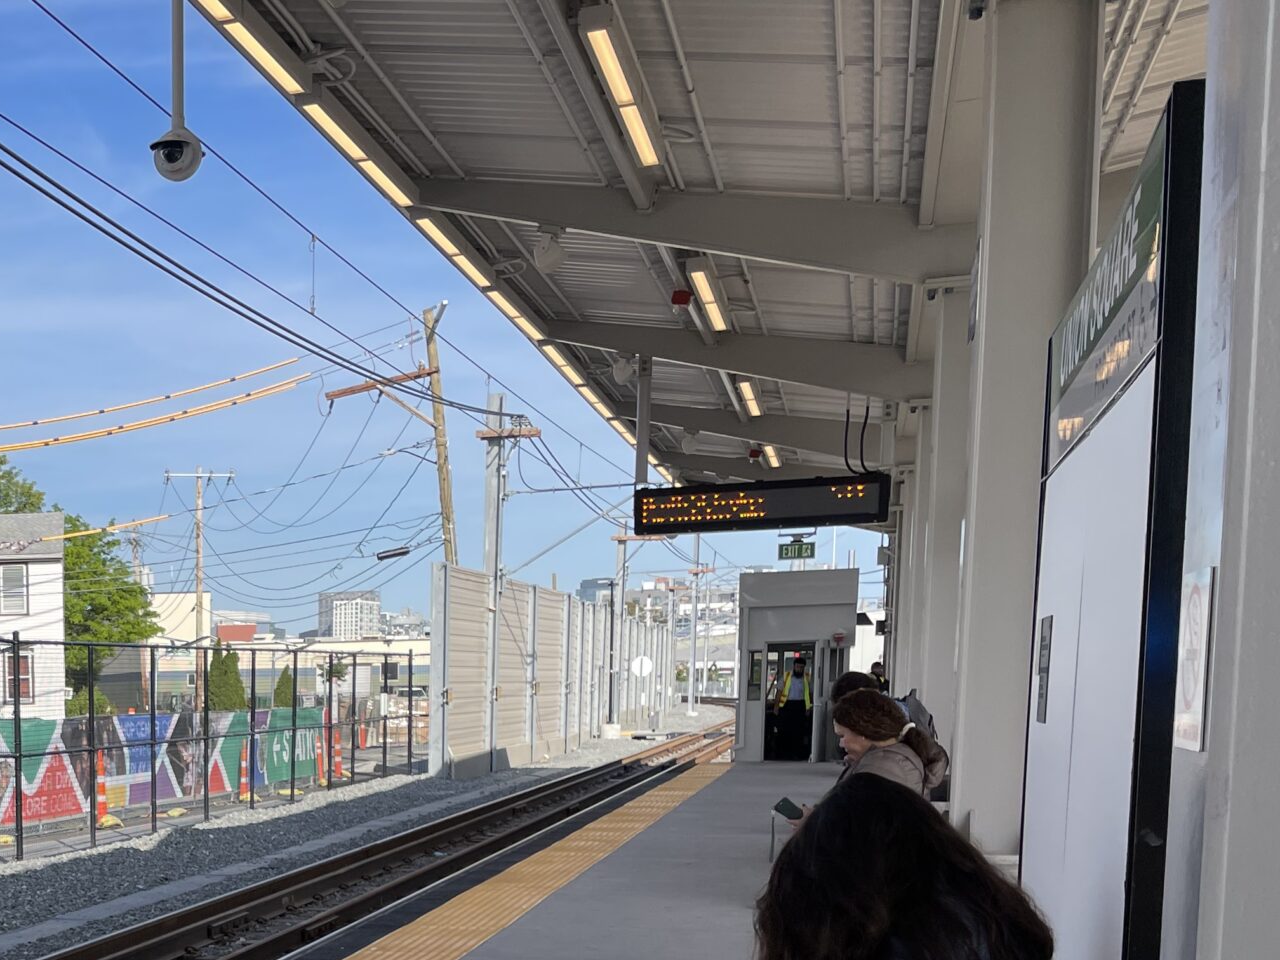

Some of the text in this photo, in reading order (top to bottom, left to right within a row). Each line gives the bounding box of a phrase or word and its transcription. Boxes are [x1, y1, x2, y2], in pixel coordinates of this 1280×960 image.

[1060, 284, 1091, 387] UNION
[1090, 184, 1142, 341] SQUARE
[782, 543, 800, 557] EXIT
